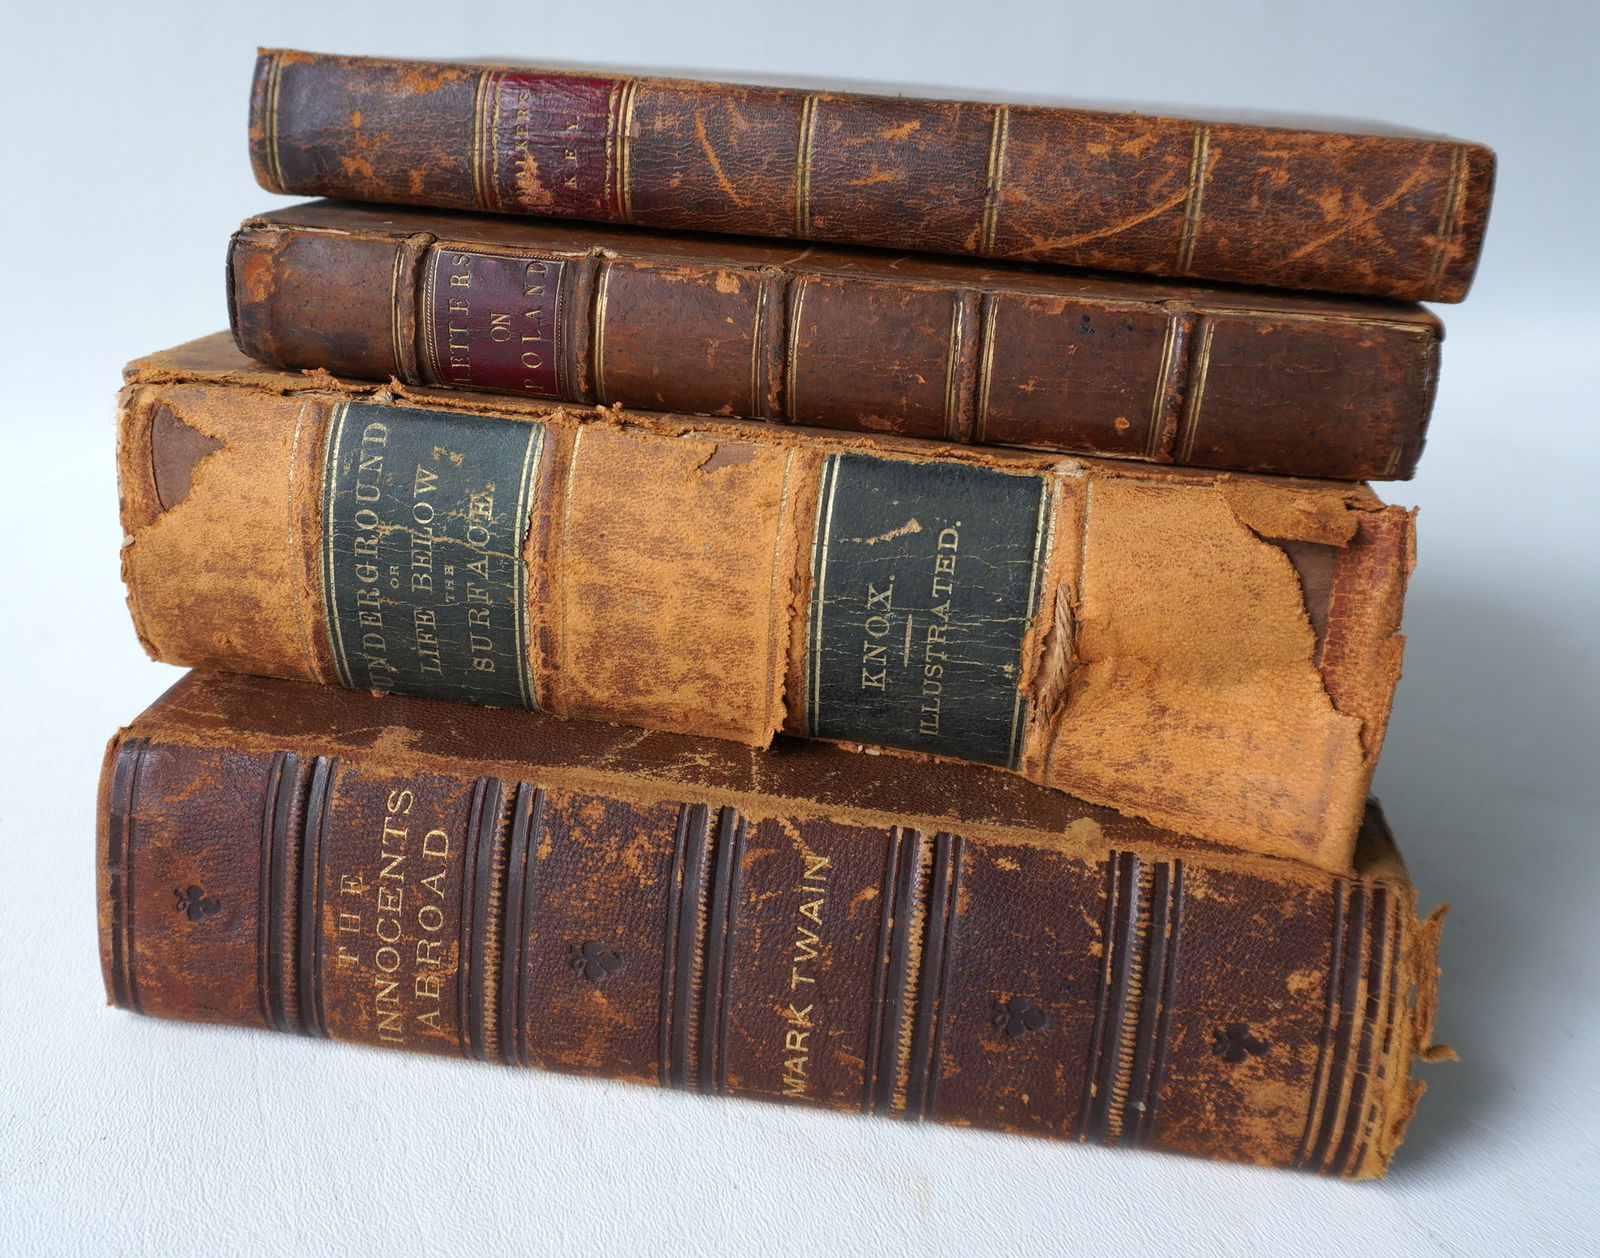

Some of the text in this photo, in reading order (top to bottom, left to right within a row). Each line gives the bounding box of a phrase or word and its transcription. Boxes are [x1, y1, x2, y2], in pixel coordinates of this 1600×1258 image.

[449, 254, 472, 382] LETTERS
[490, 312, 512, 343] ON
[523, 261, 548, 390] POLAND
[354, 422, 395, 688] UNDERGROUND
[388, 564, 399, 589] OR
[411, 463, 442, 676] LIFE BELOW
[444, 565, 455, 602] THE
[861, 575, 896, 691] KNOX.
[919, 521, 962, 735] ILLUSTRATED.
[338, 874, 363, 967] THE
[374, 790, 413, 1043] INNOCENTS
[415, 829, 449, 1030] ABROAD
[782, 855, 829, 1098] MARK TWAIN
